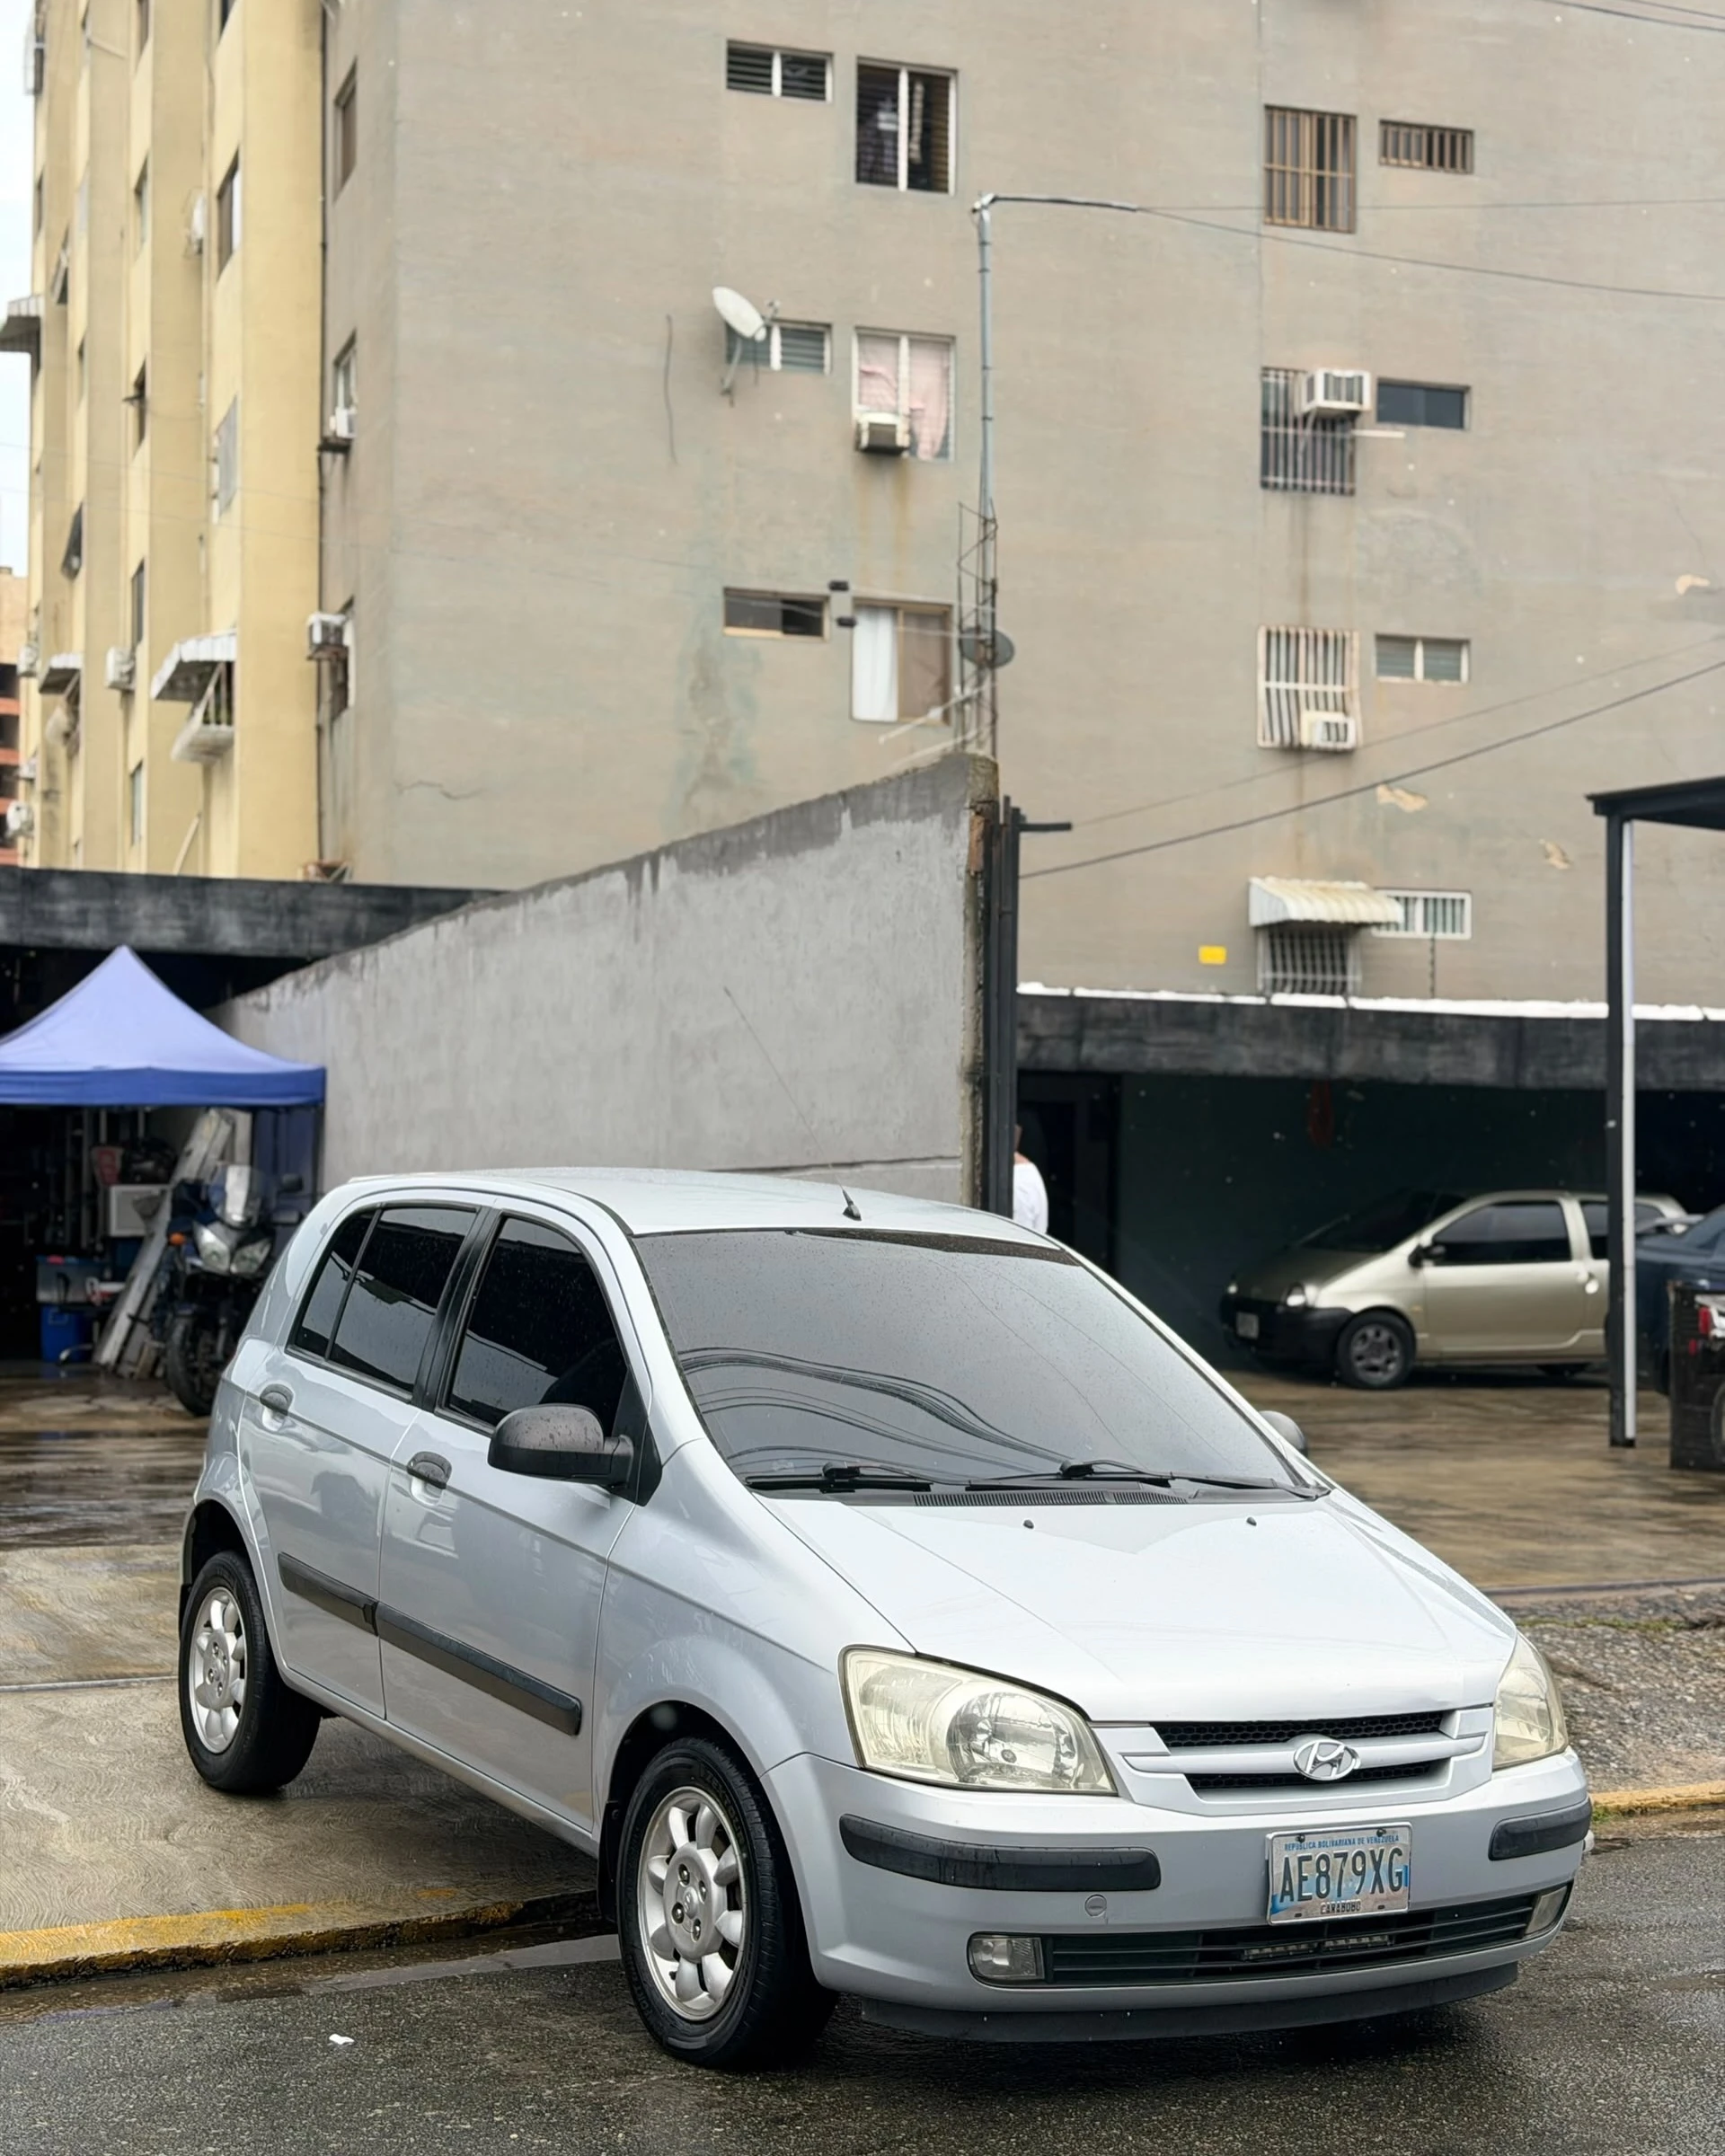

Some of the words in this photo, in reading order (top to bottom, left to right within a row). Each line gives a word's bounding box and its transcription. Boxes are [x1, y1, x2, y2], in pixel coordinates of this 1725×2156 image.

[1317, 1837, 1357, 1849] BOLIVARIANA
[1358, 1836, 1366, 1845] DE
[1366, 1834, 1400, 1844] VENEZUELA
[1279, 1847, 1403, 1904] AE879XG
[1321, 1900, 1361, 1914] CARABOBO
